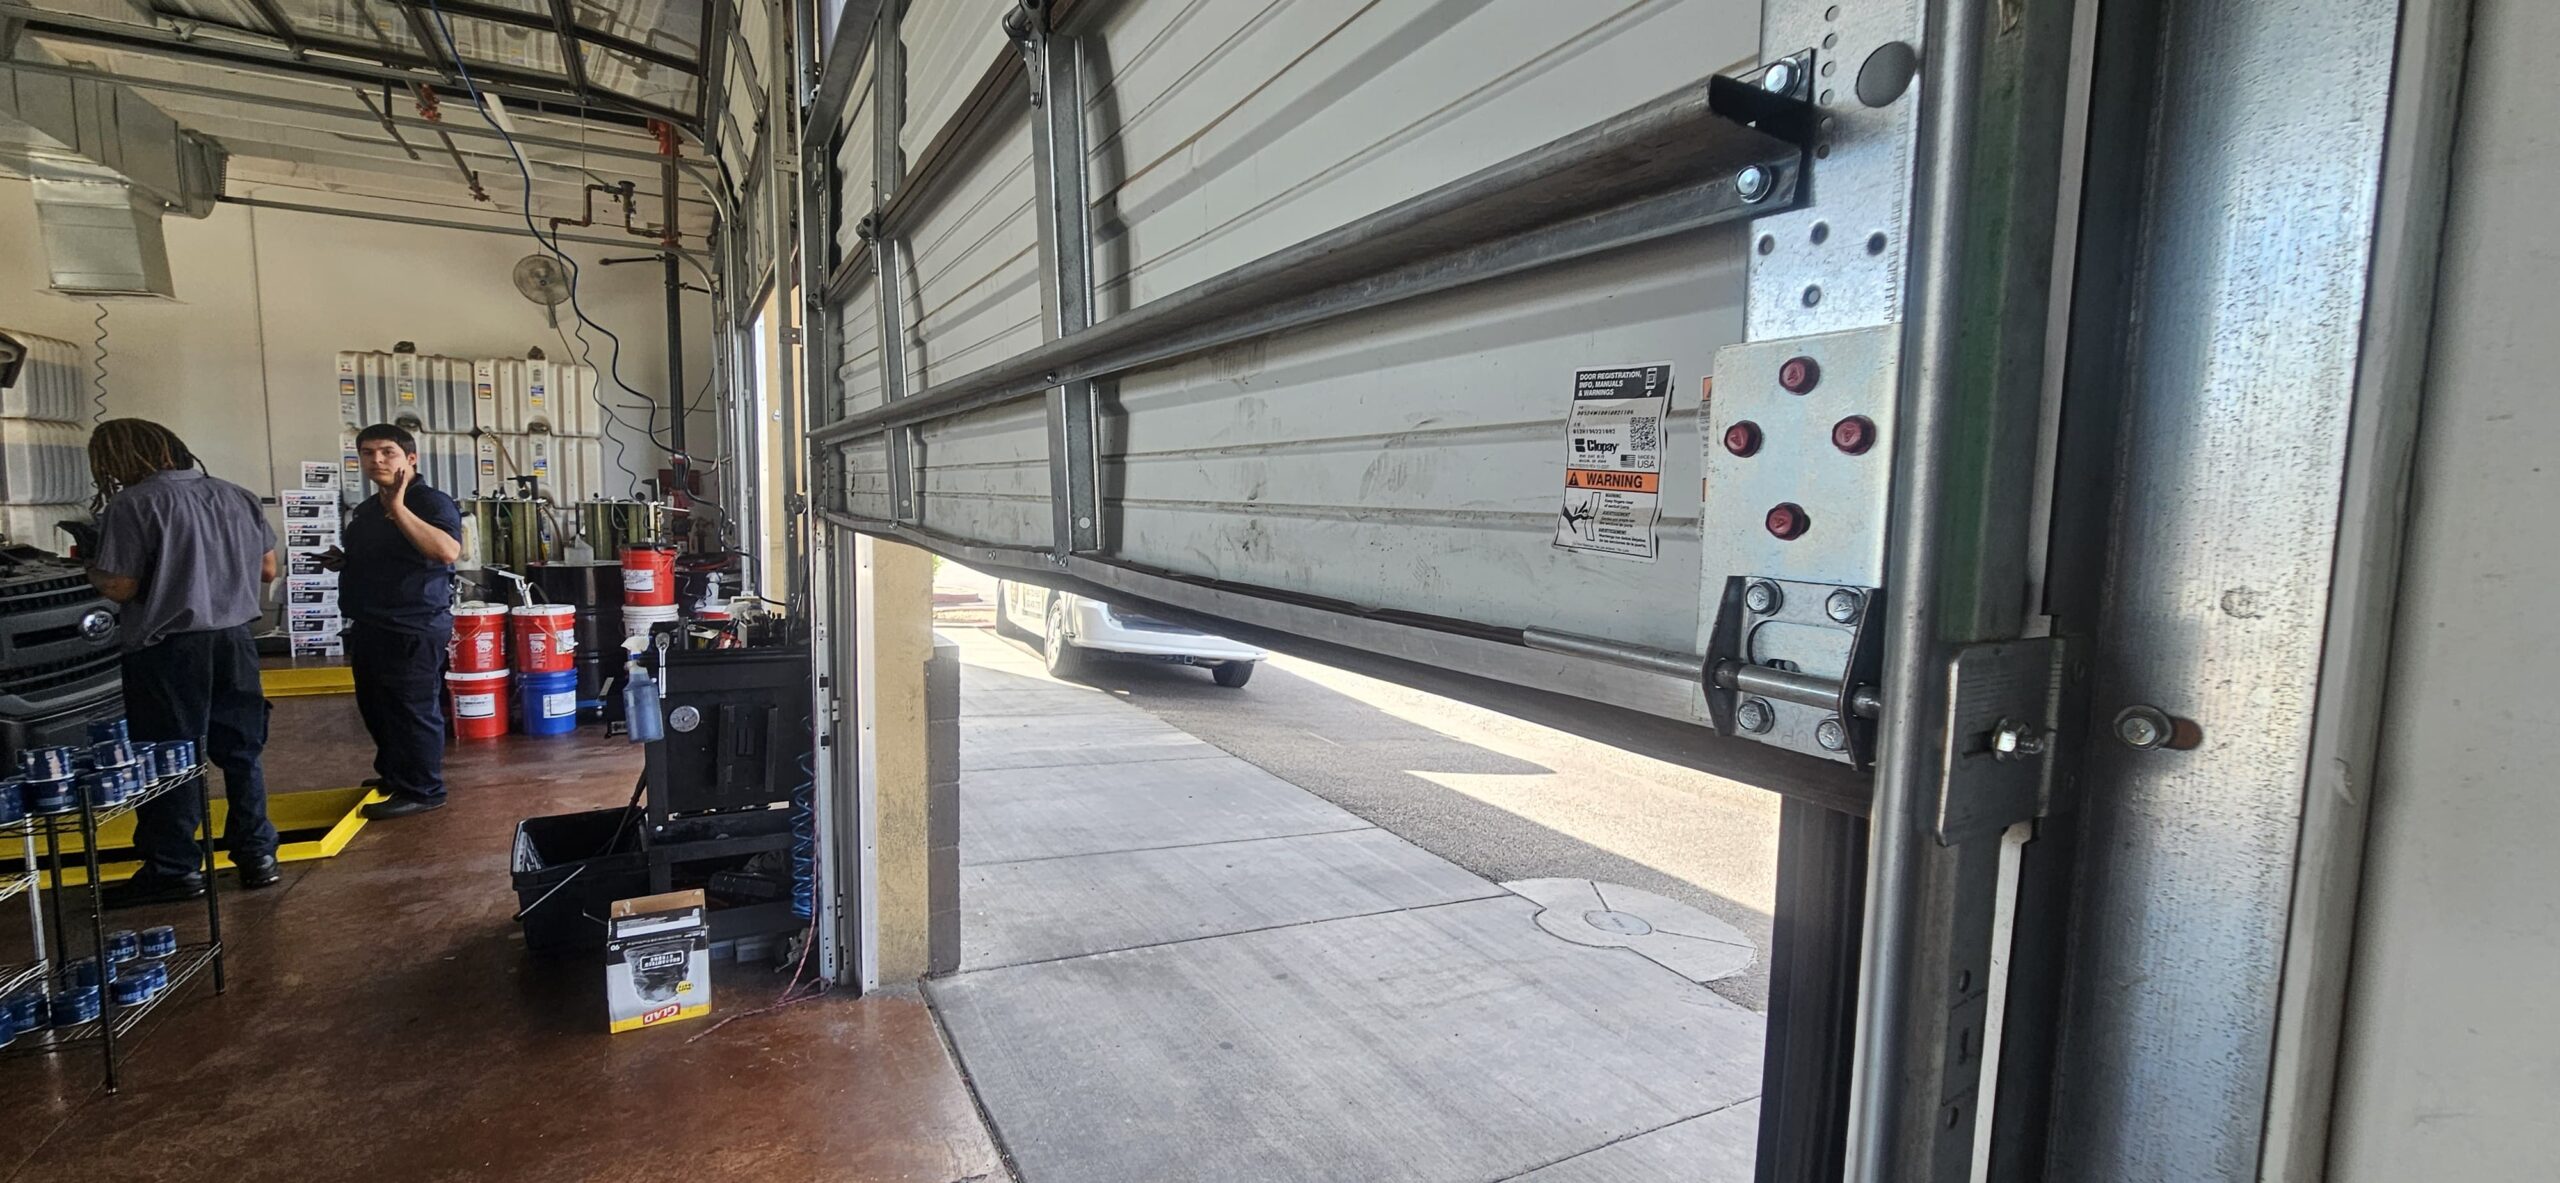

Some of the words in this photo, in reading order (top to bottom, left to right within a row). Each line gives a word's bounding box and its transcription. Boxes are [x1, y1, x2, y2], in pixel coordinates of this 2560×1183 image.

[1597, 371, 1642, 379] REGISTRATION,
[1595, 380, 1623, 388] MANUALS
[1586, 440, 1617, 454] Clopay
[1637, 460, 1655, 469] USA
[1586, 472, 1643, 488] WARNING
[644, 1005, 679, 1024] GLAD
